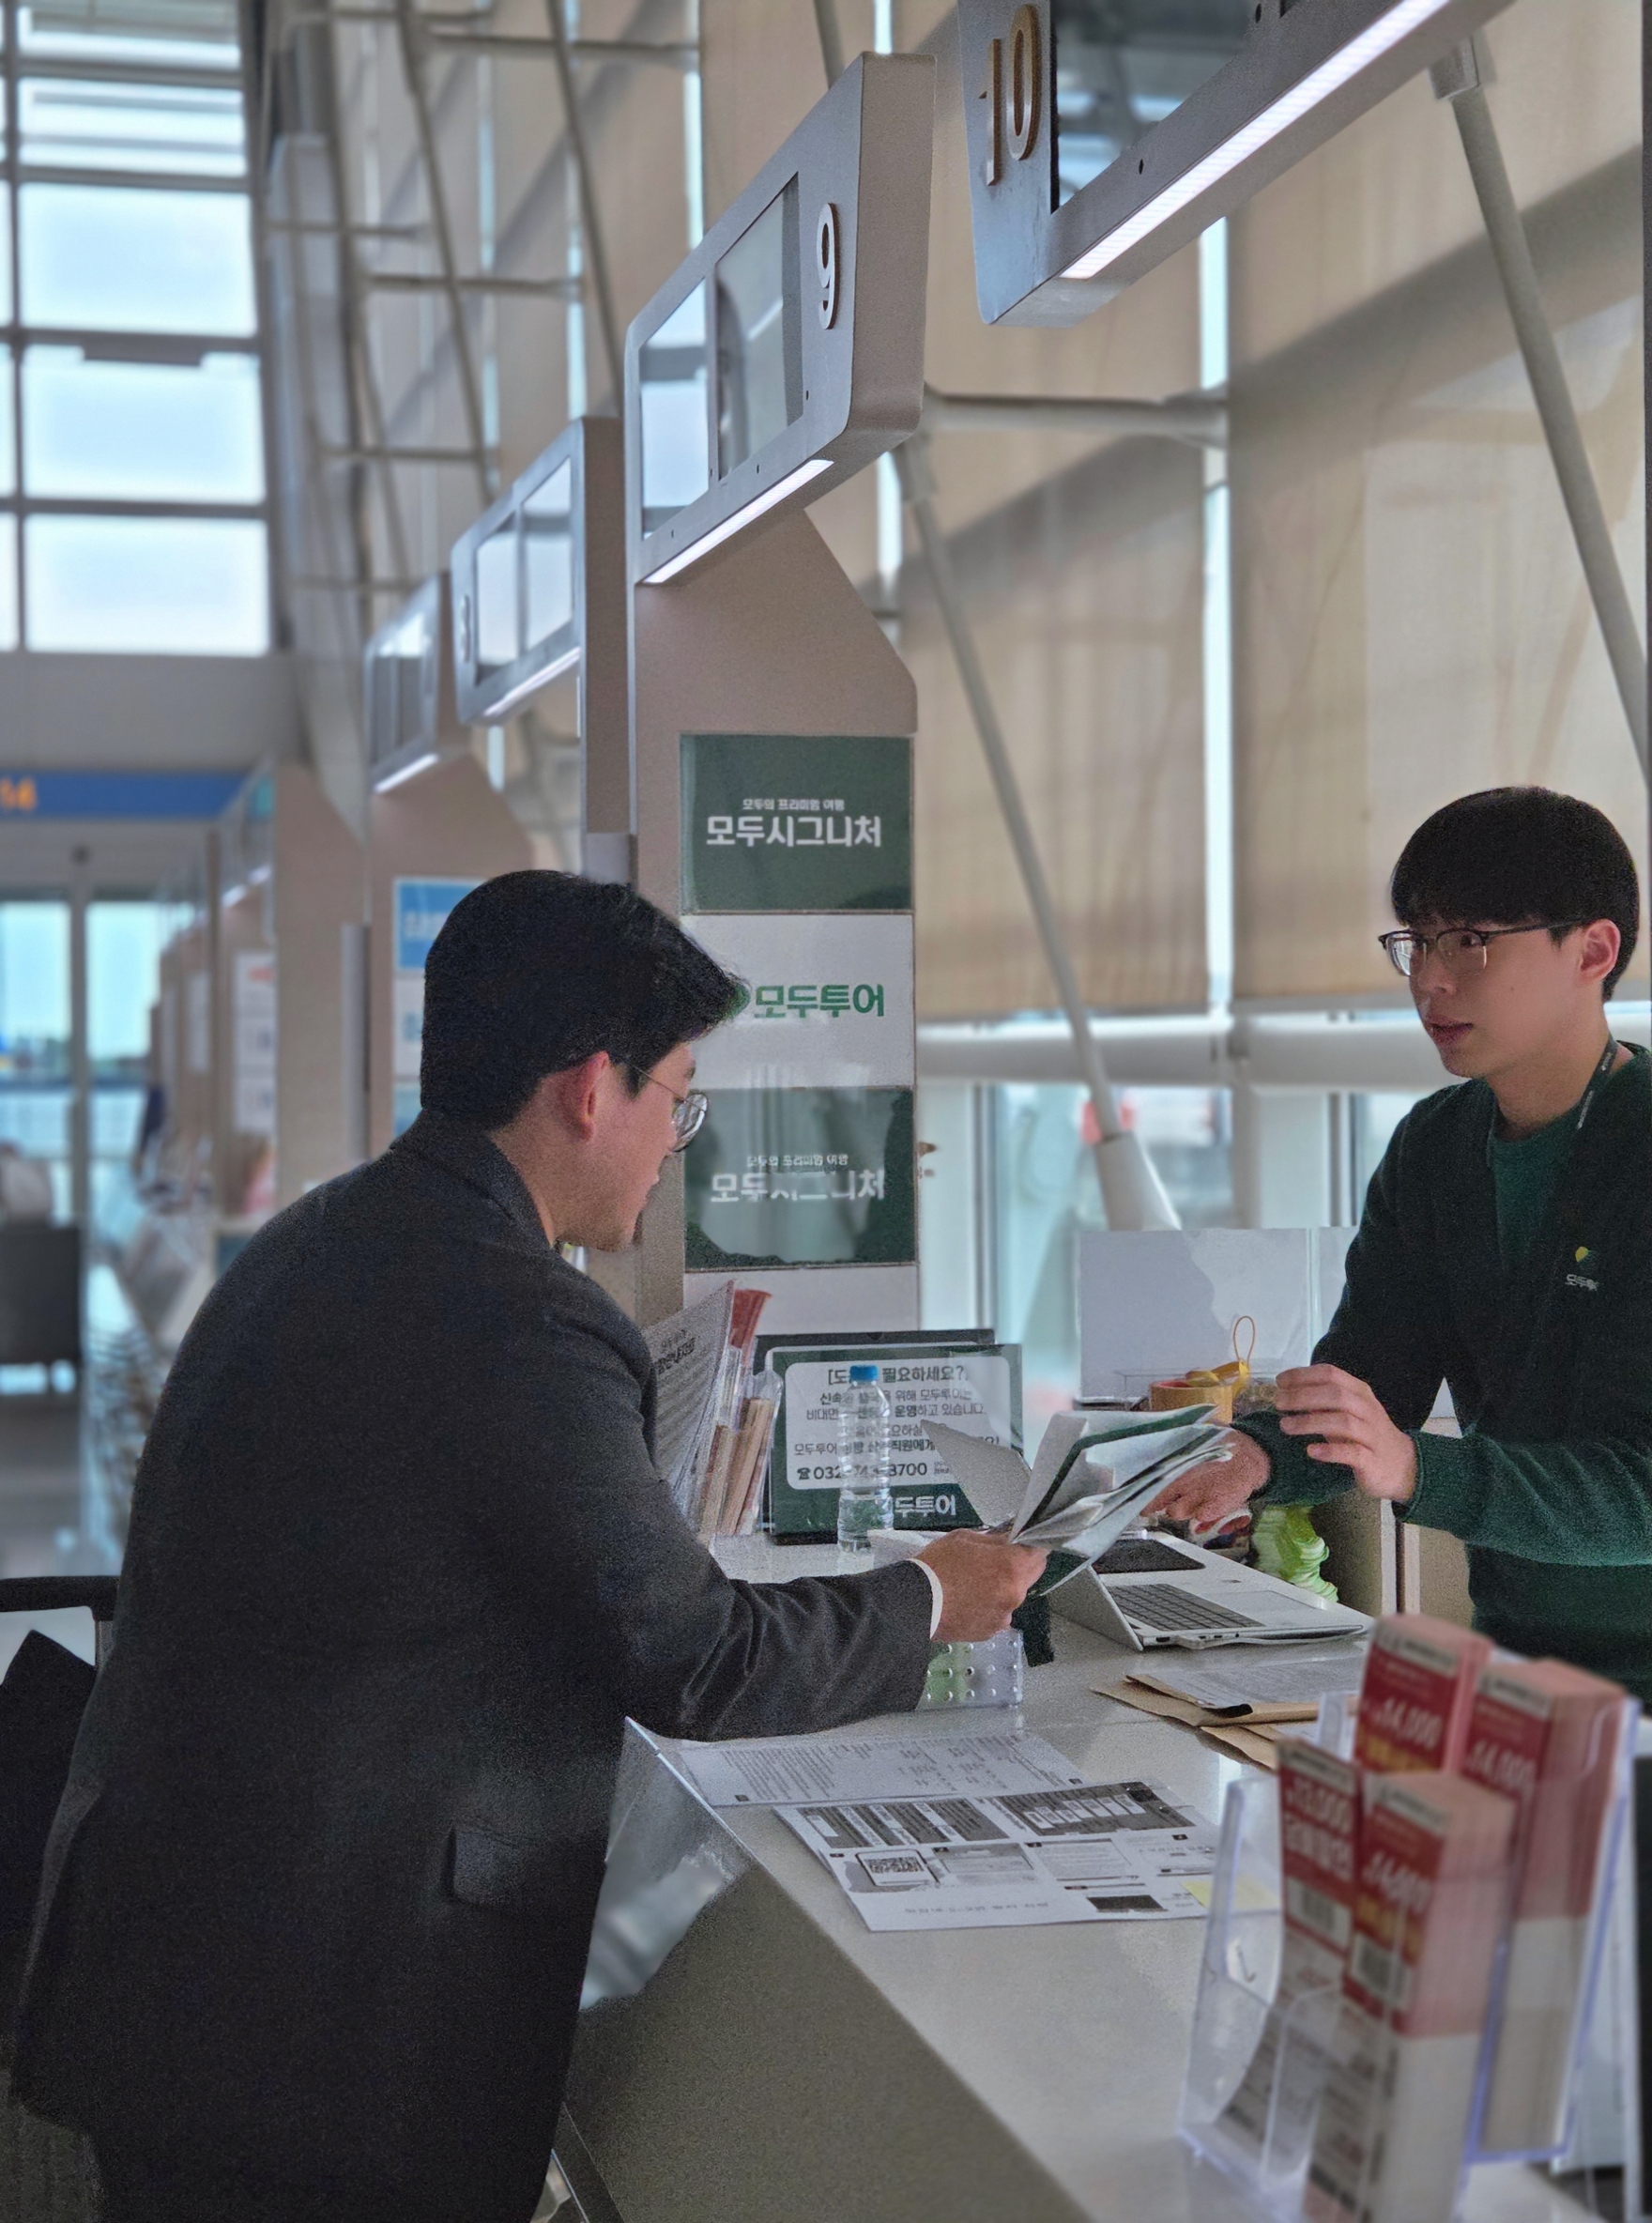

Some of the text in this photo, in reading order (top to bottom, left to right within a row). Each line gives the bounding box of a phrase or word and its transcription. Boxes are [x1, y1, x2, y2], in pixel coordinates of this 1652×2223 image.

[978, 4, 1042, 186] 10
[817, 203, 840, 330] 9
[707, 816, 881, 848] 모두시그니처
[754, 984, 884, 1019] 모두투어
[895, 1389, 917, 1402] 위해
[895, 1403, 939, 1418] 운영하고
[794, 1442, 837, 1456] 모두투어
[895, 1495, 956, 1517] 두투어
